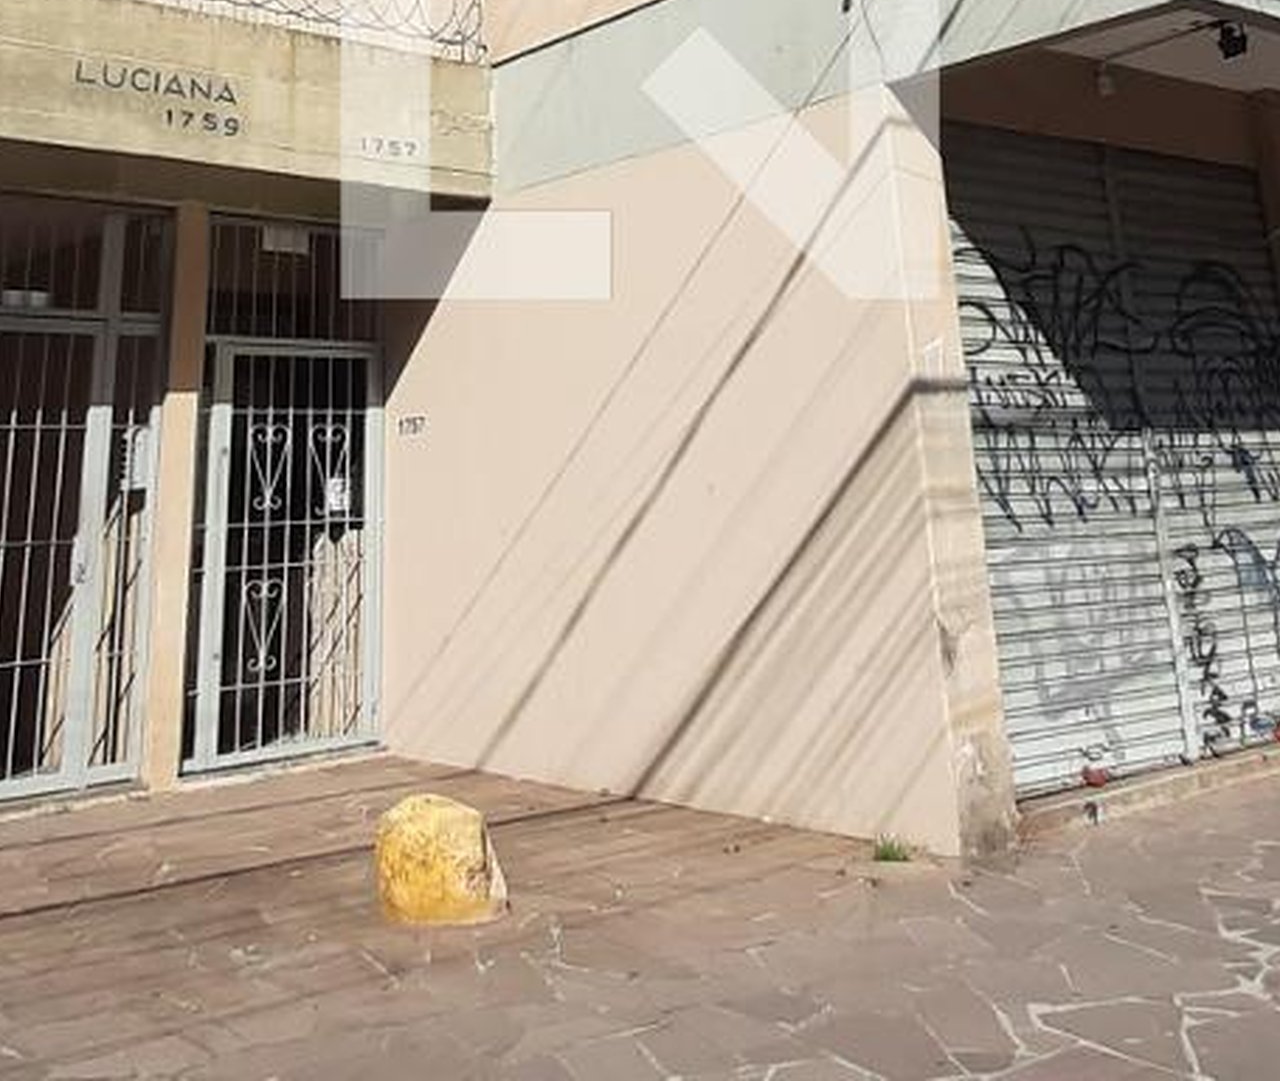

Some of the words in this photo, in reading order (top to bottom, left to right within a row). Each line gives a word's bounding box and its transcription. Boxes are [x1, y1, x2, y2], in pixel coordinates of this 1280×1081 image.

[76, 60, 238, 105] LUCIANA
[164, 108, 240, 137] 1759
[360, 137, 418, 157] 1757
